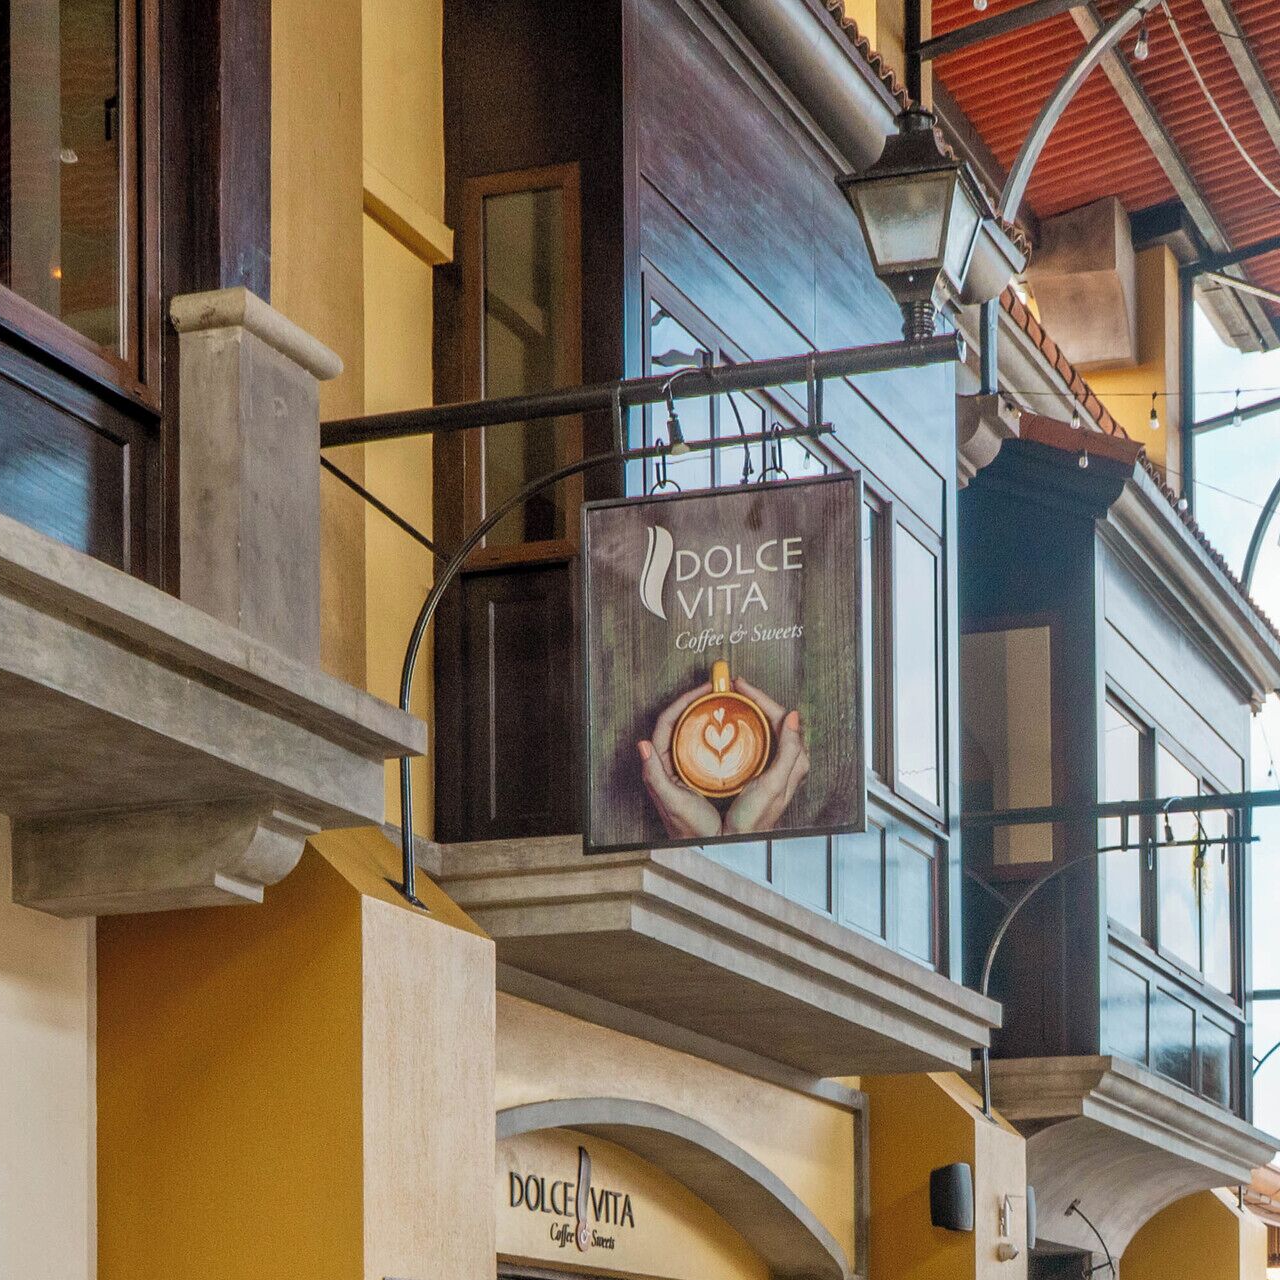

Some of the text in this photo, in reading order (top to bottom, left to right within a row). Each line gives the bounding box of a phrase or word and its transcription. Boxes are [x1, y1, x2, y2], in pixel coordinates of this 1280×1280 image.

[675, 537, 803, 582] DOLCE
[676, 581, 769, 620] VITA
[675, 623, 804, 653] Coffee & Sweets
[509, 1171, 635, 1229] DOLCE VITA
[550, 1222, 615, 1250] Coffee Sweets
